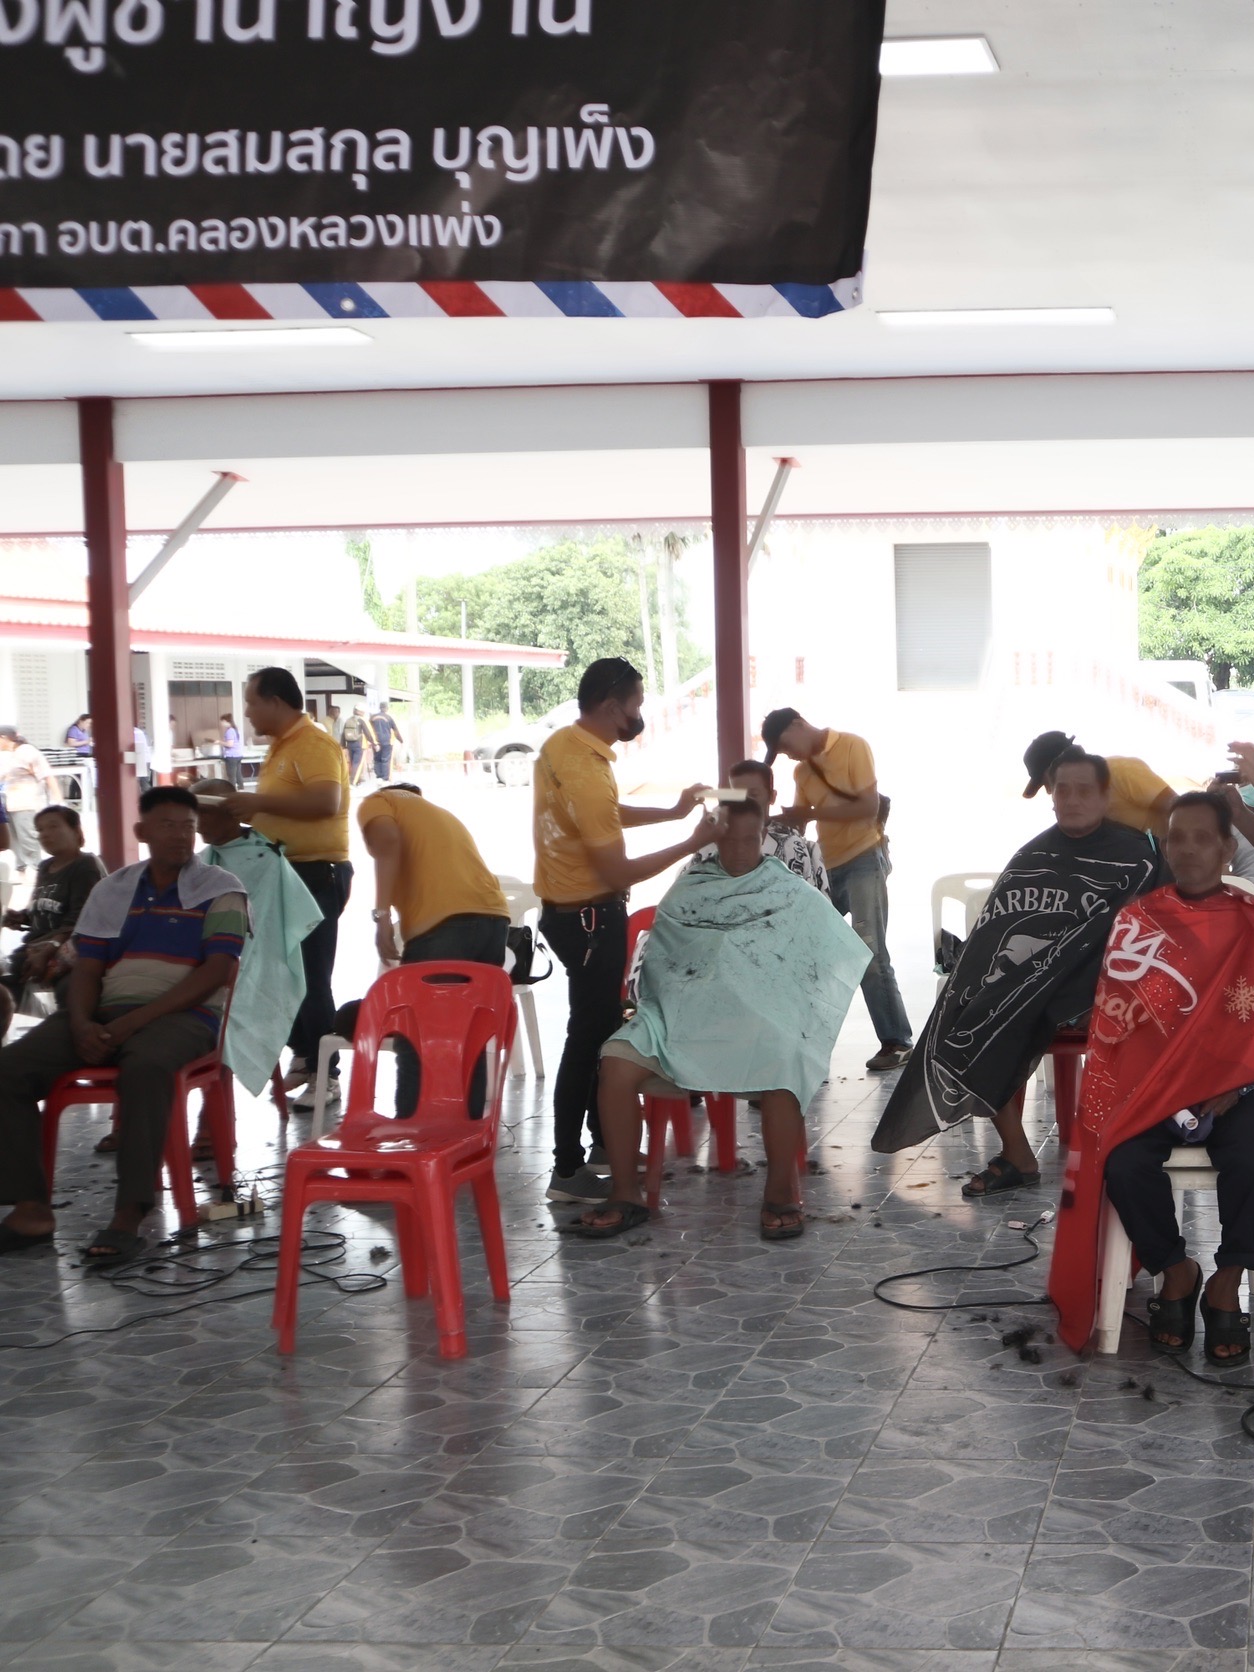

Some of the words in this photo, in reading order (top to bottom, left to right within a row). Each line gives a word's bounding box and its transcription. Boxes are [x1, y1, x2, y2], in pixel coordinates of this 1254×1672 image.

[83, 127, 412, 191] นายสมสกุล
[432, 103, 655, 190] บุญเพ็ง
[57, 200, 502, 254] อบต.คลองหลวงแพ่ง
[976, 887, 1069, 930] BARBER
